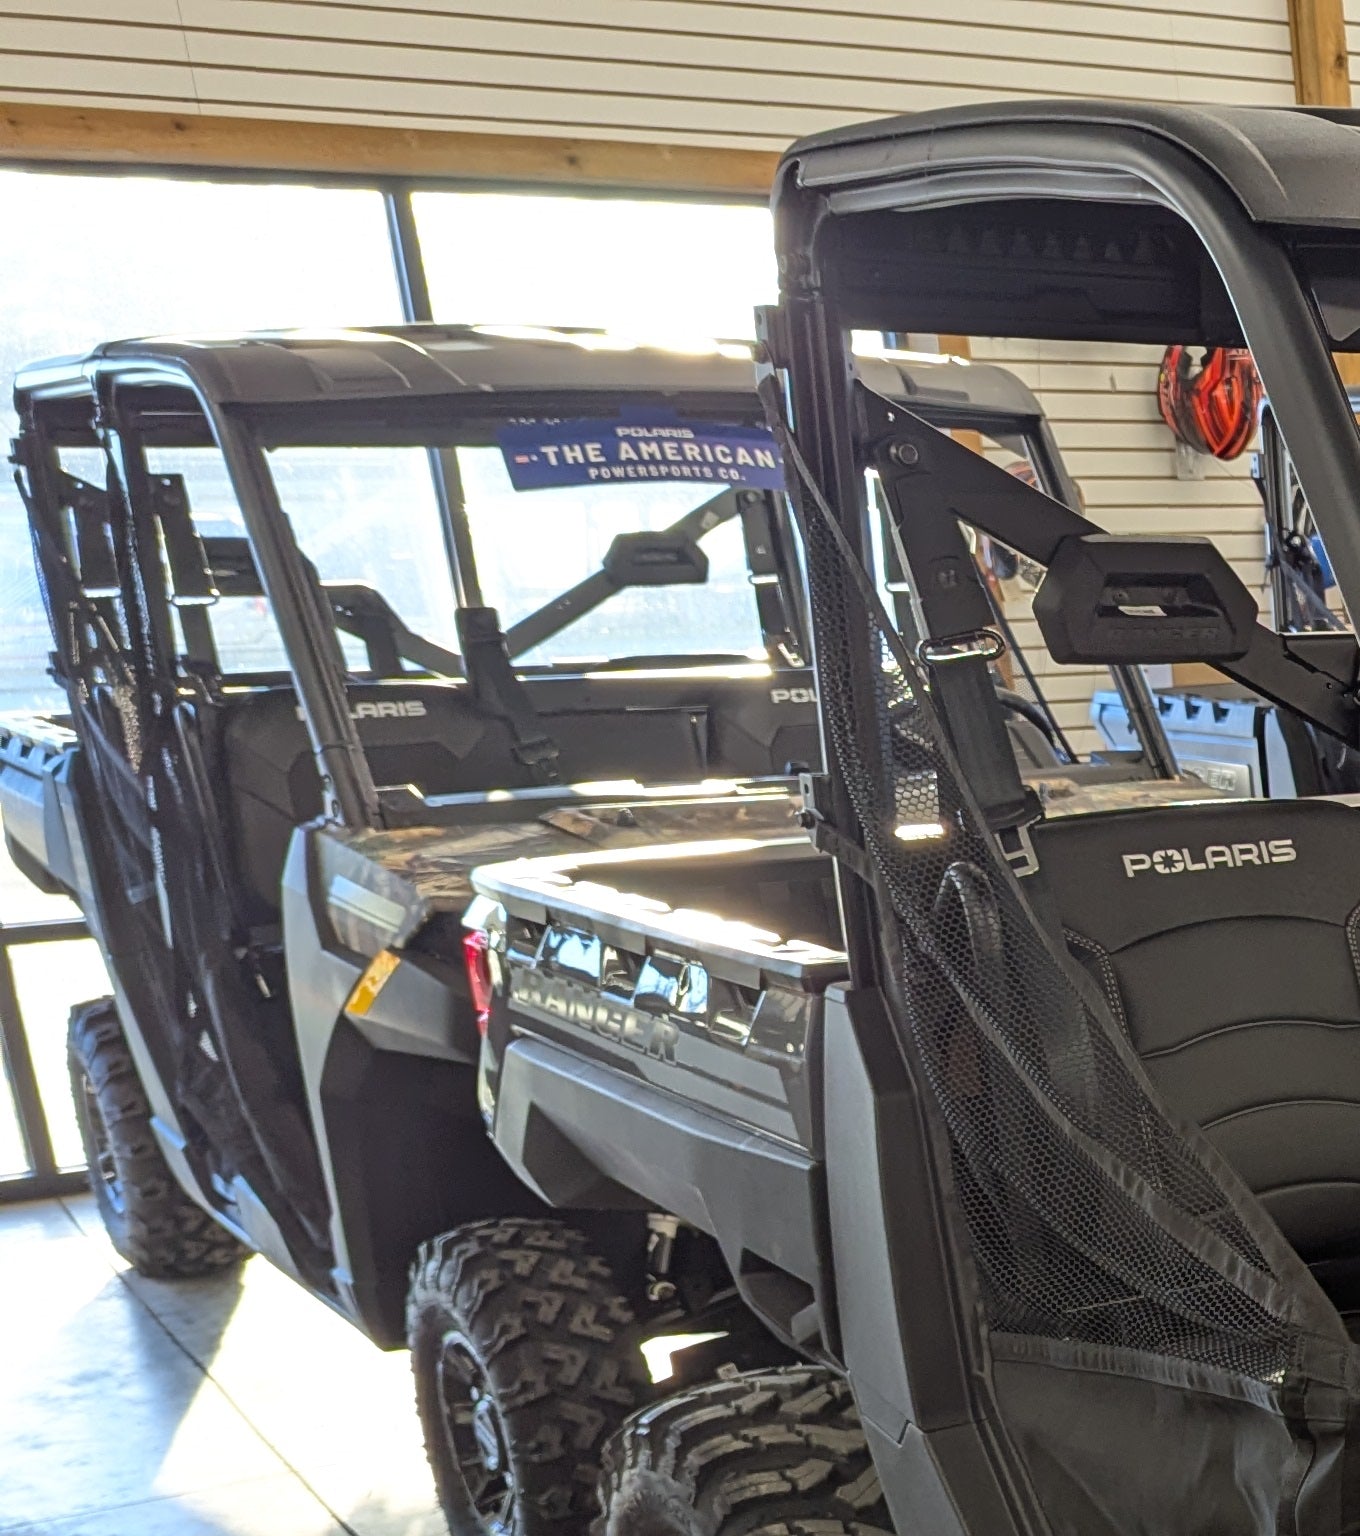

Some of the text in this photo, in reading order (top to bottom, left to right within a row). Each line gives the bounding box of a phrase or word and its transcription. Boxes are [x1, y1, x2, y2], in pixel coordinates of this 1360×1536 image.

[615, 426, 695, 439] POLARIS
[540, 441, 776, 468] THE AMERICAN
[588, 466, 746, 481] POWERSPORTS CO.
[1121, 838, 1297, 878] POLARIS
[509, 967, 681, 1066] RANGER
